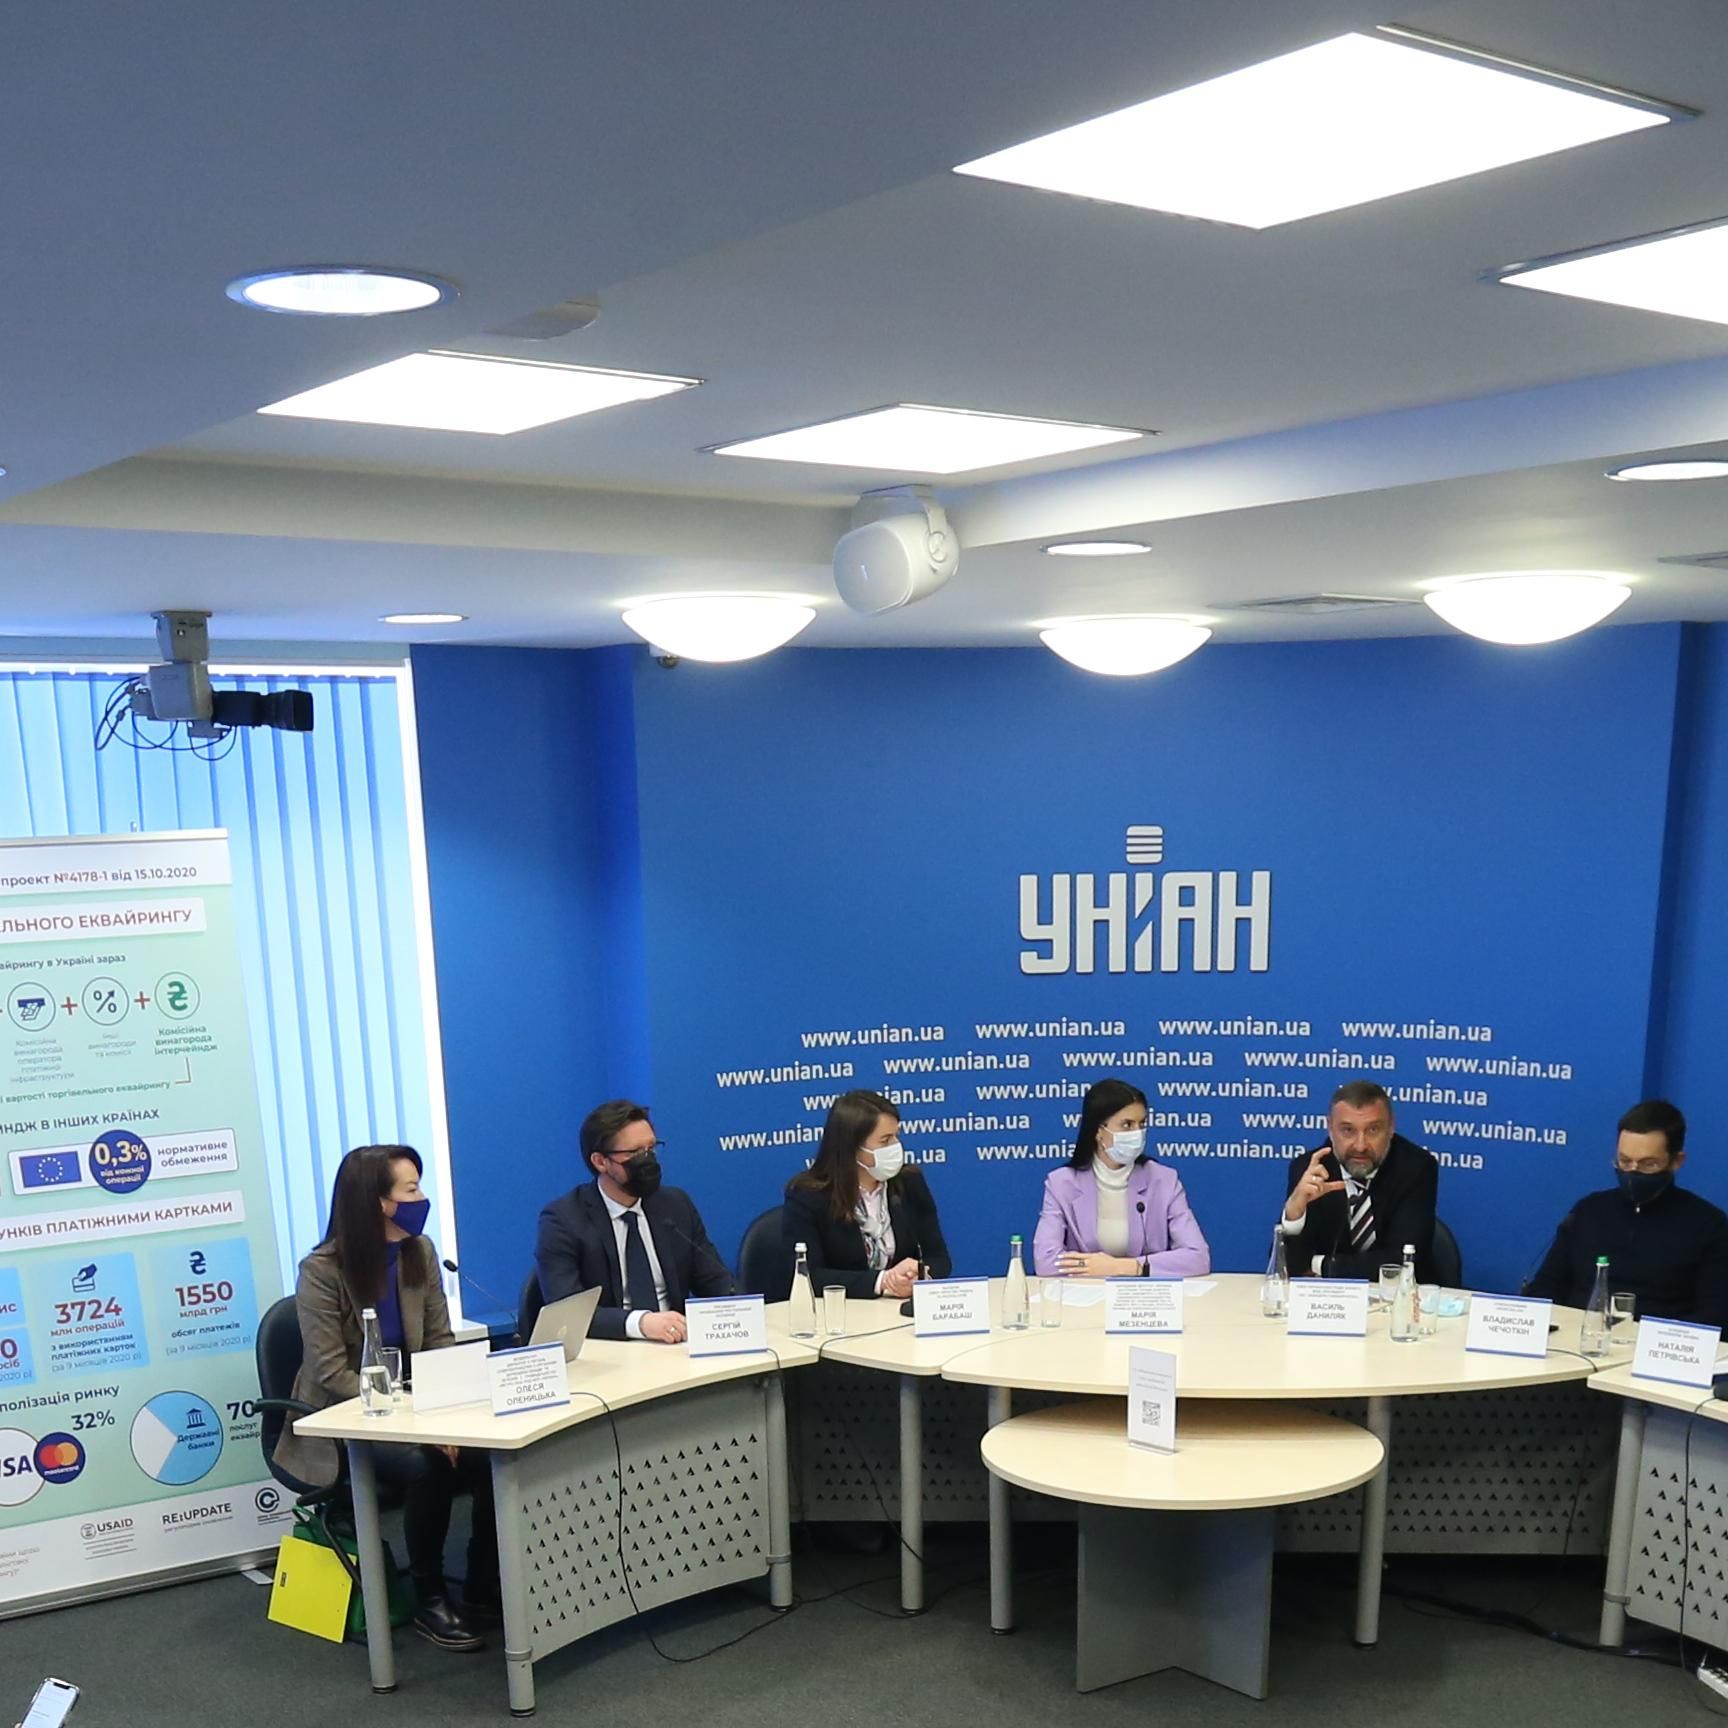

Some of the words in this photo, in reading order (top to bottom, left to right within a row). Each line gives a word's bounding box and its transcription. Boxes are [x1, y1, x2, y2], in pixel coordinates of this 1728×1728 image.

[111, 869, 132, 881] від
[135, 866, 197, 880] 15.10.2020
[79, 909, 192, 929] ЕКВАЙРИНГУ
[1019, 868, 1271, 975] УНІАН
[55, 956, 94, 968] Україні
[97, 954, 126, 964] зараз
[155, 1034, 212, 1046] винагорода
[158, 1025, 207, 1036] Комісійна
[802, 1024, 945, 1048] www.unian.ua
[976, 1017, 1126, 1039] www.unian.ua
[1159, 1016, 1311, 1036] www.unian.ua
[1342, 1019, 1492, 1042] www.unian.ua
[716, 1061, 854, 1087] www.unian.ua
[884, 1051, 1030, 1074] www.unian.ua
[1063, 1047, 1213, 1067] www.unian.ua
[1244, 1048, 1396, 1070] www.unian.ua
[1426, 1056, 1572, 1080] www.unian.ua
[1158, 1078, 1308, 1098] www.unian.ua
[41, 1119, 50, 1130] В
[53, 1115, 99, 1130] ІНШИХ
[102, 1108, 160, 1124] КРАЇНАХ
[1423, 1118, 1567, 1145] www.unian.ua
[94, 1140, 147, 1167] 0,3%
[157, 1140, 228, 1157] нормативне
[160, 1152, 228, 1168] обмеження
[47, 1211, 151, 1234] ПЛАТІЖНИМИ
[154, 1201, 233, 1221] КАРТКАМИ
[175, 1281, 234, 1308] 1550
[54, 1296, 123, 1325] 3724
[179, 1307, 207, 1320] млрд
[208, 1305, 228, 1318] грн
[50, 1326, 73, 1337] млн
[75, 1318, 125, 1334] операцій
[171, 1326, 197, 1339] обсяг
[199, 1320, 241, 1334] платежів
[73, 1384, 120, 1403] ринку
[226, 1399, 257, 1420] 70
[71, 1409, 115, 1431] 32%
[162, 1502, 232, 1525] RE:UPDATE
[97, 1518, 134, 1533] USAID
